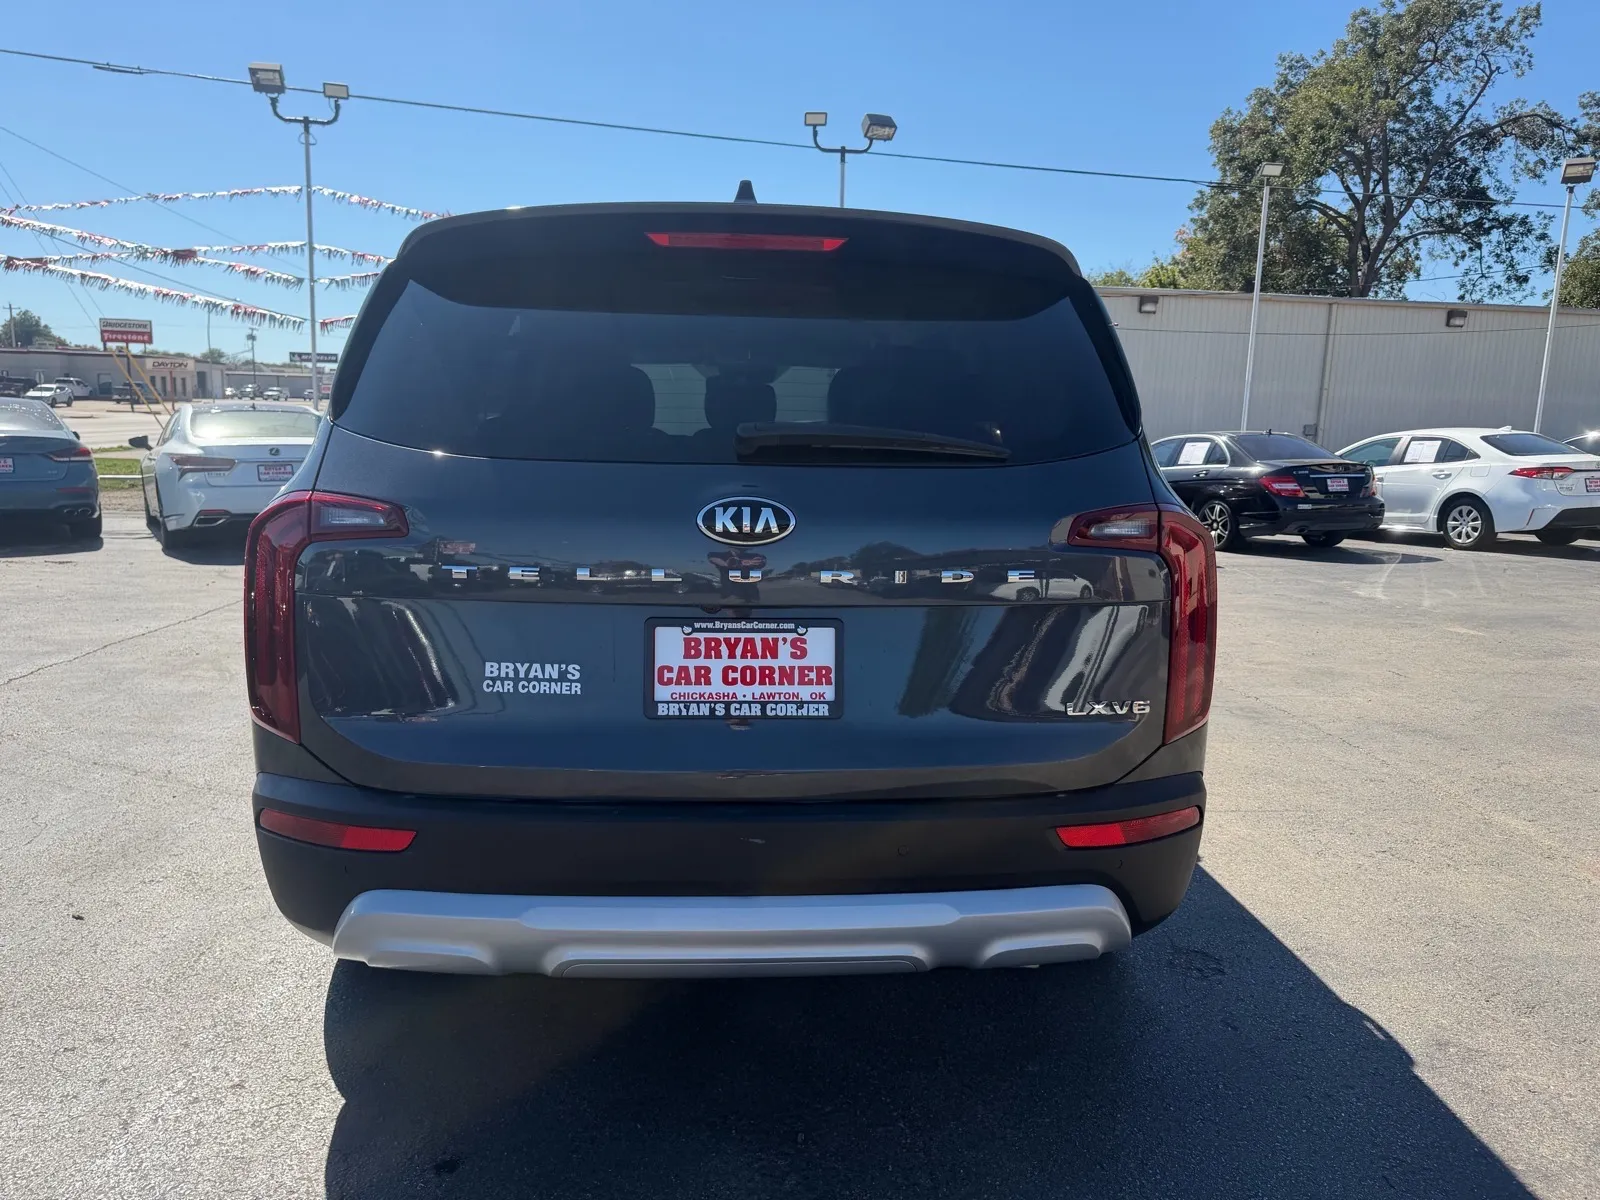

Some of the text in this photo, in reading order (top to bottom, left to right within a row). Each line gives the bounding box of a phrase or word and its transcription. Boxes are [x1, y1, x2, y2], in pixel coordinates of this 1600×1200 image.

[102, 321, 149, 329] BRIDGESTONE
[103, 333, 150, 341] Firestone
[714, 506, 779, 533] KIA
[441, 565, 1036, 584] TELLURIDE
[694, 621, 795, 630] www.BryansCarCorner.com
[682, 636, 808, 660] BRYAN'S
[485, 661, 581, 680] BRYAN'S
[656, 665, 833, 687] CAR CORNER
[482, 680, 582, 695] CAR CORNER
[670, 692, 827, 701] CHICKASHA LAWTON, OK
[657, 702, 830, 716] BRYAN'S CAR CORNER
